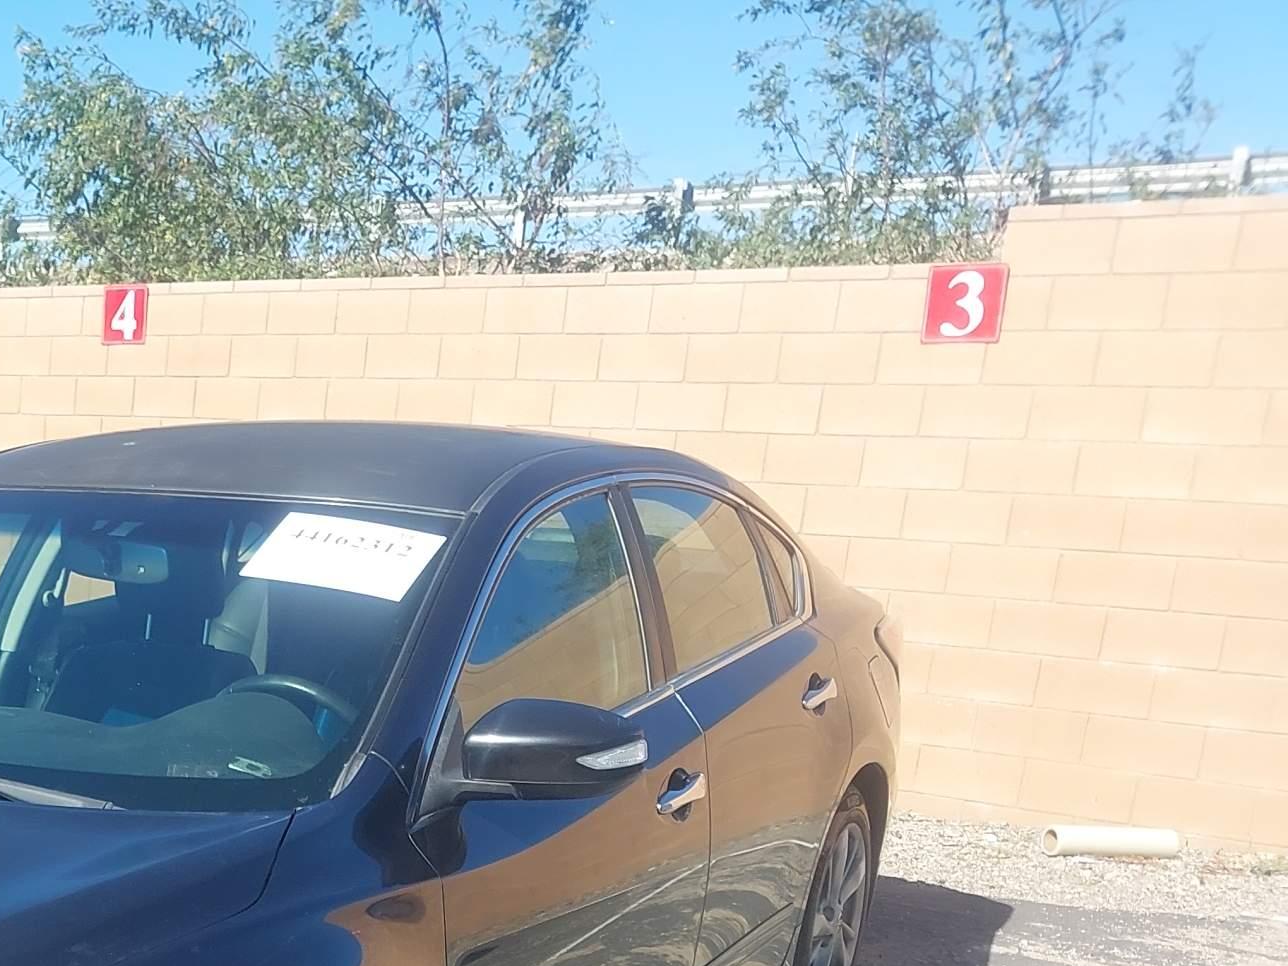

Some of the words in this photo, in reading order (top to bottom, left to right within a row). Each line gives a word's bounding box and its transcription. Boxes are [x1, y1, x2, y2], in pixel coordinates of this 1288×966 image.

[111, 289, 137, 340] 4
[939, 270, 985, 337] 3
[290, 528, 414, 558] 44162312
